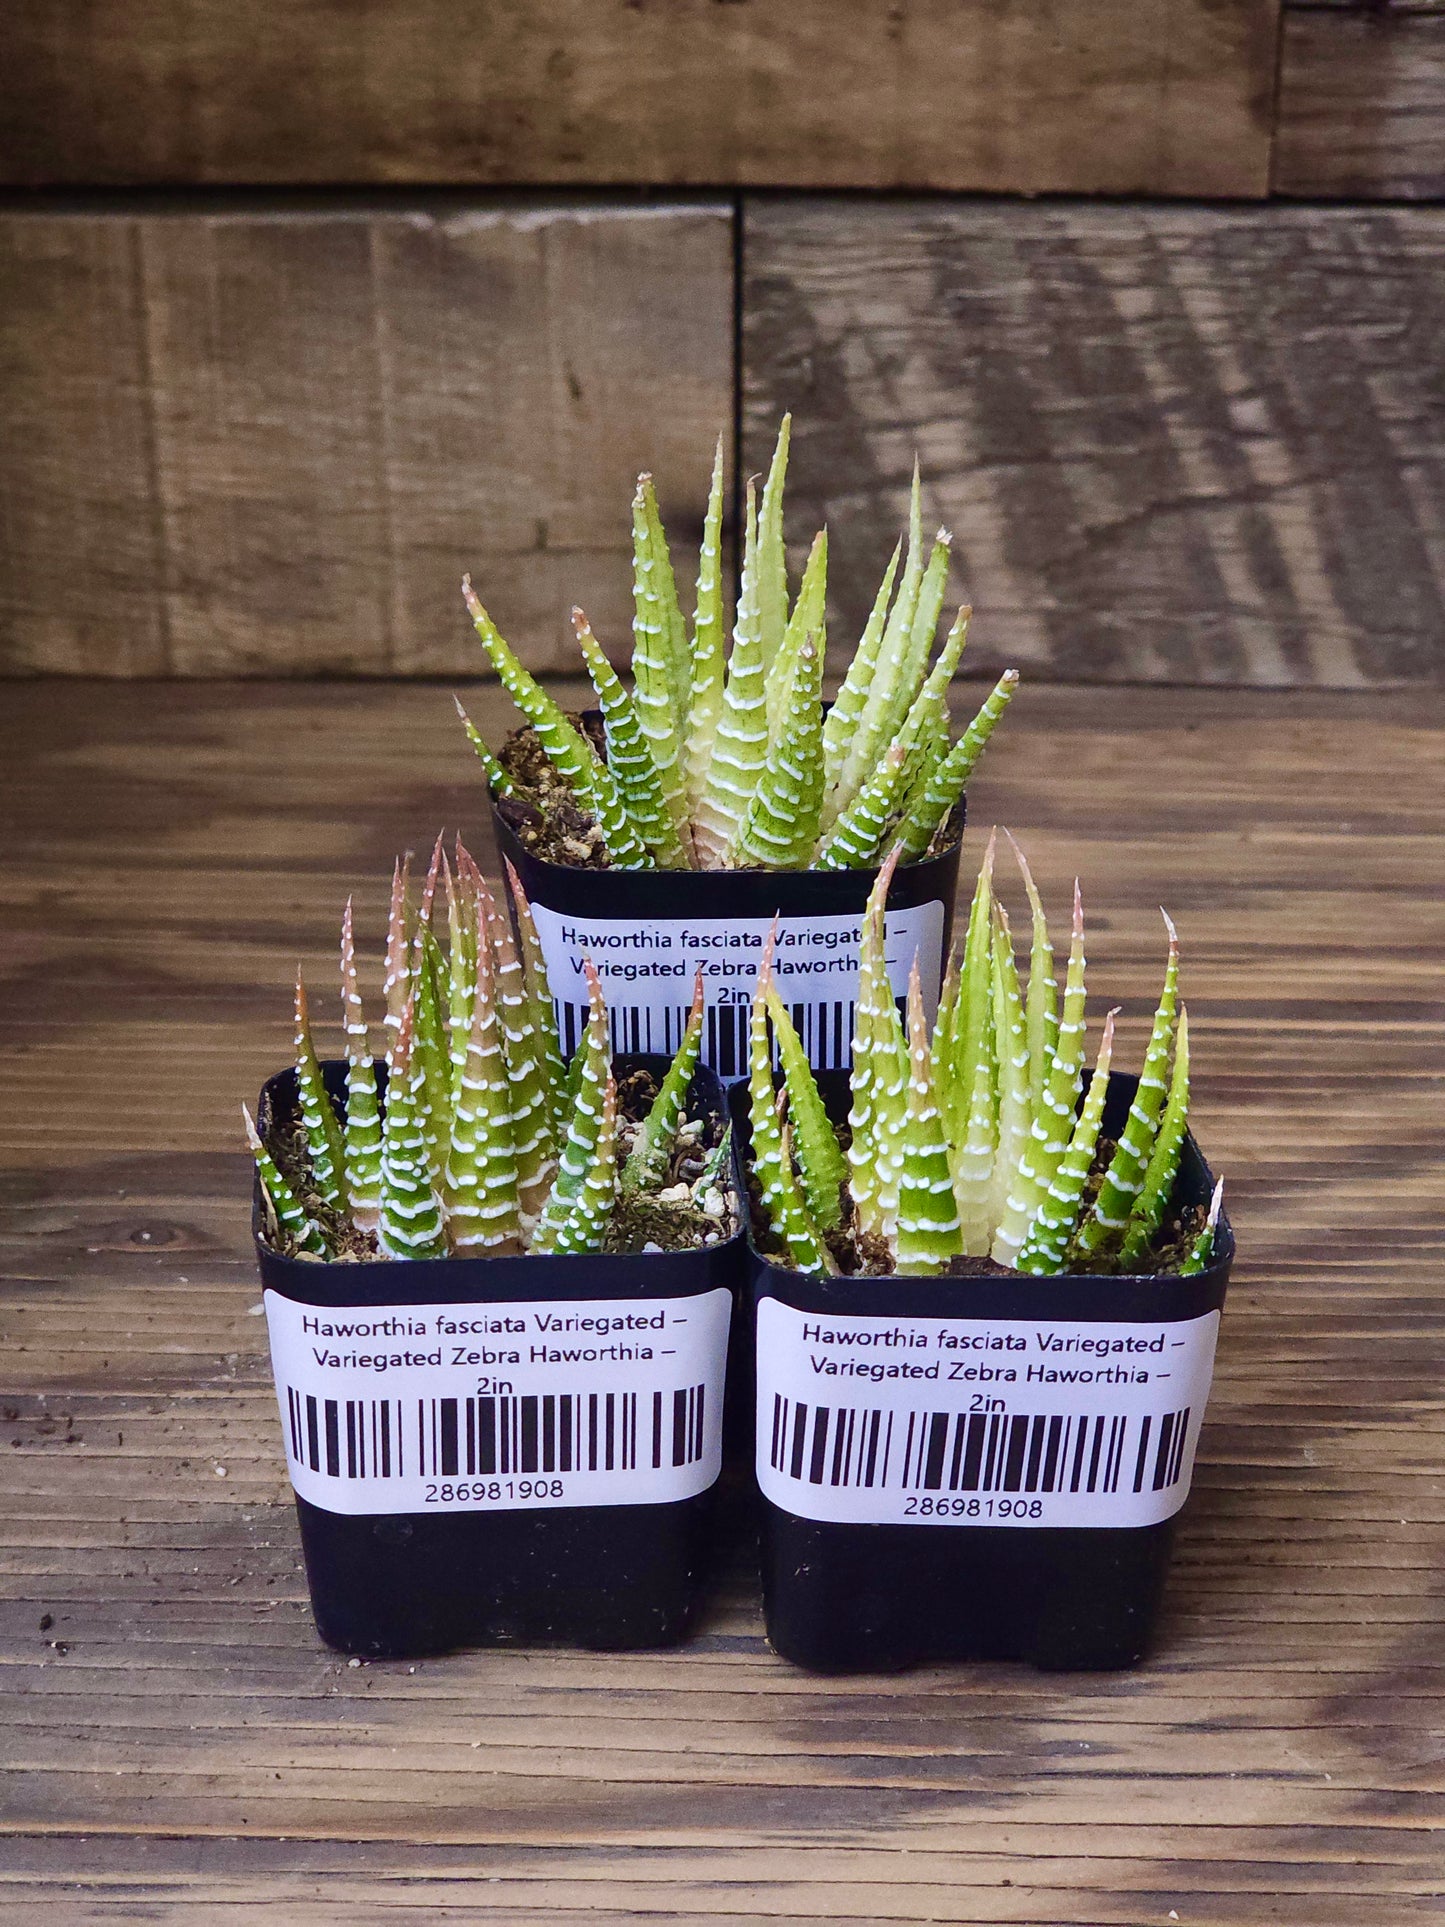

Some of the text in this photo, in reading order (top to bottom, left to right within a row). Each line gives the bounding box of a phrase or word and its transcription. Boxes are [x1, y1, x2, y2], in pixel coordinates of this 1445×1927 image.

[562, 925, 672, 948] Haworthia
[680, 929, 762, 948] fasciata
[774, 924, 887, 949] Variegat
[570, 955, 686, 981] Vriegated
[694, 958, 757, 976] Zebra
[770, 953, 859, 975] Haworth
[717, 986, 751, 1004] 2in
[303, 1315, 426, 1337] Haworthia
[435, 1315, 526, 1335] fasciata
[534, 1311, 665, 1333] Variegated
[803, 1324, 928, 1348] Haworthia
[937, 1329, 1027, 1351] fasciata
[1036, 1332, 1165, 1357] Variegated
[311, 1347, 443, 1372] Variegated
[450, 1346, 521, 1366] Zebra
[529, 1343, 654, 1363] Haworthia
[809, 1355, 940, 1383] Variegated
[947, 1361, 1018, 1383] Zebra
[1026, 1364, 1150, 1384] Haworthia
[476, 1377, 514, 1396] 2in
[968, 1393, 1007, 1413] 2in
[424, 1480, 565, 1504] 286981908
[903, 1496, 1044, 1520] 286981908
